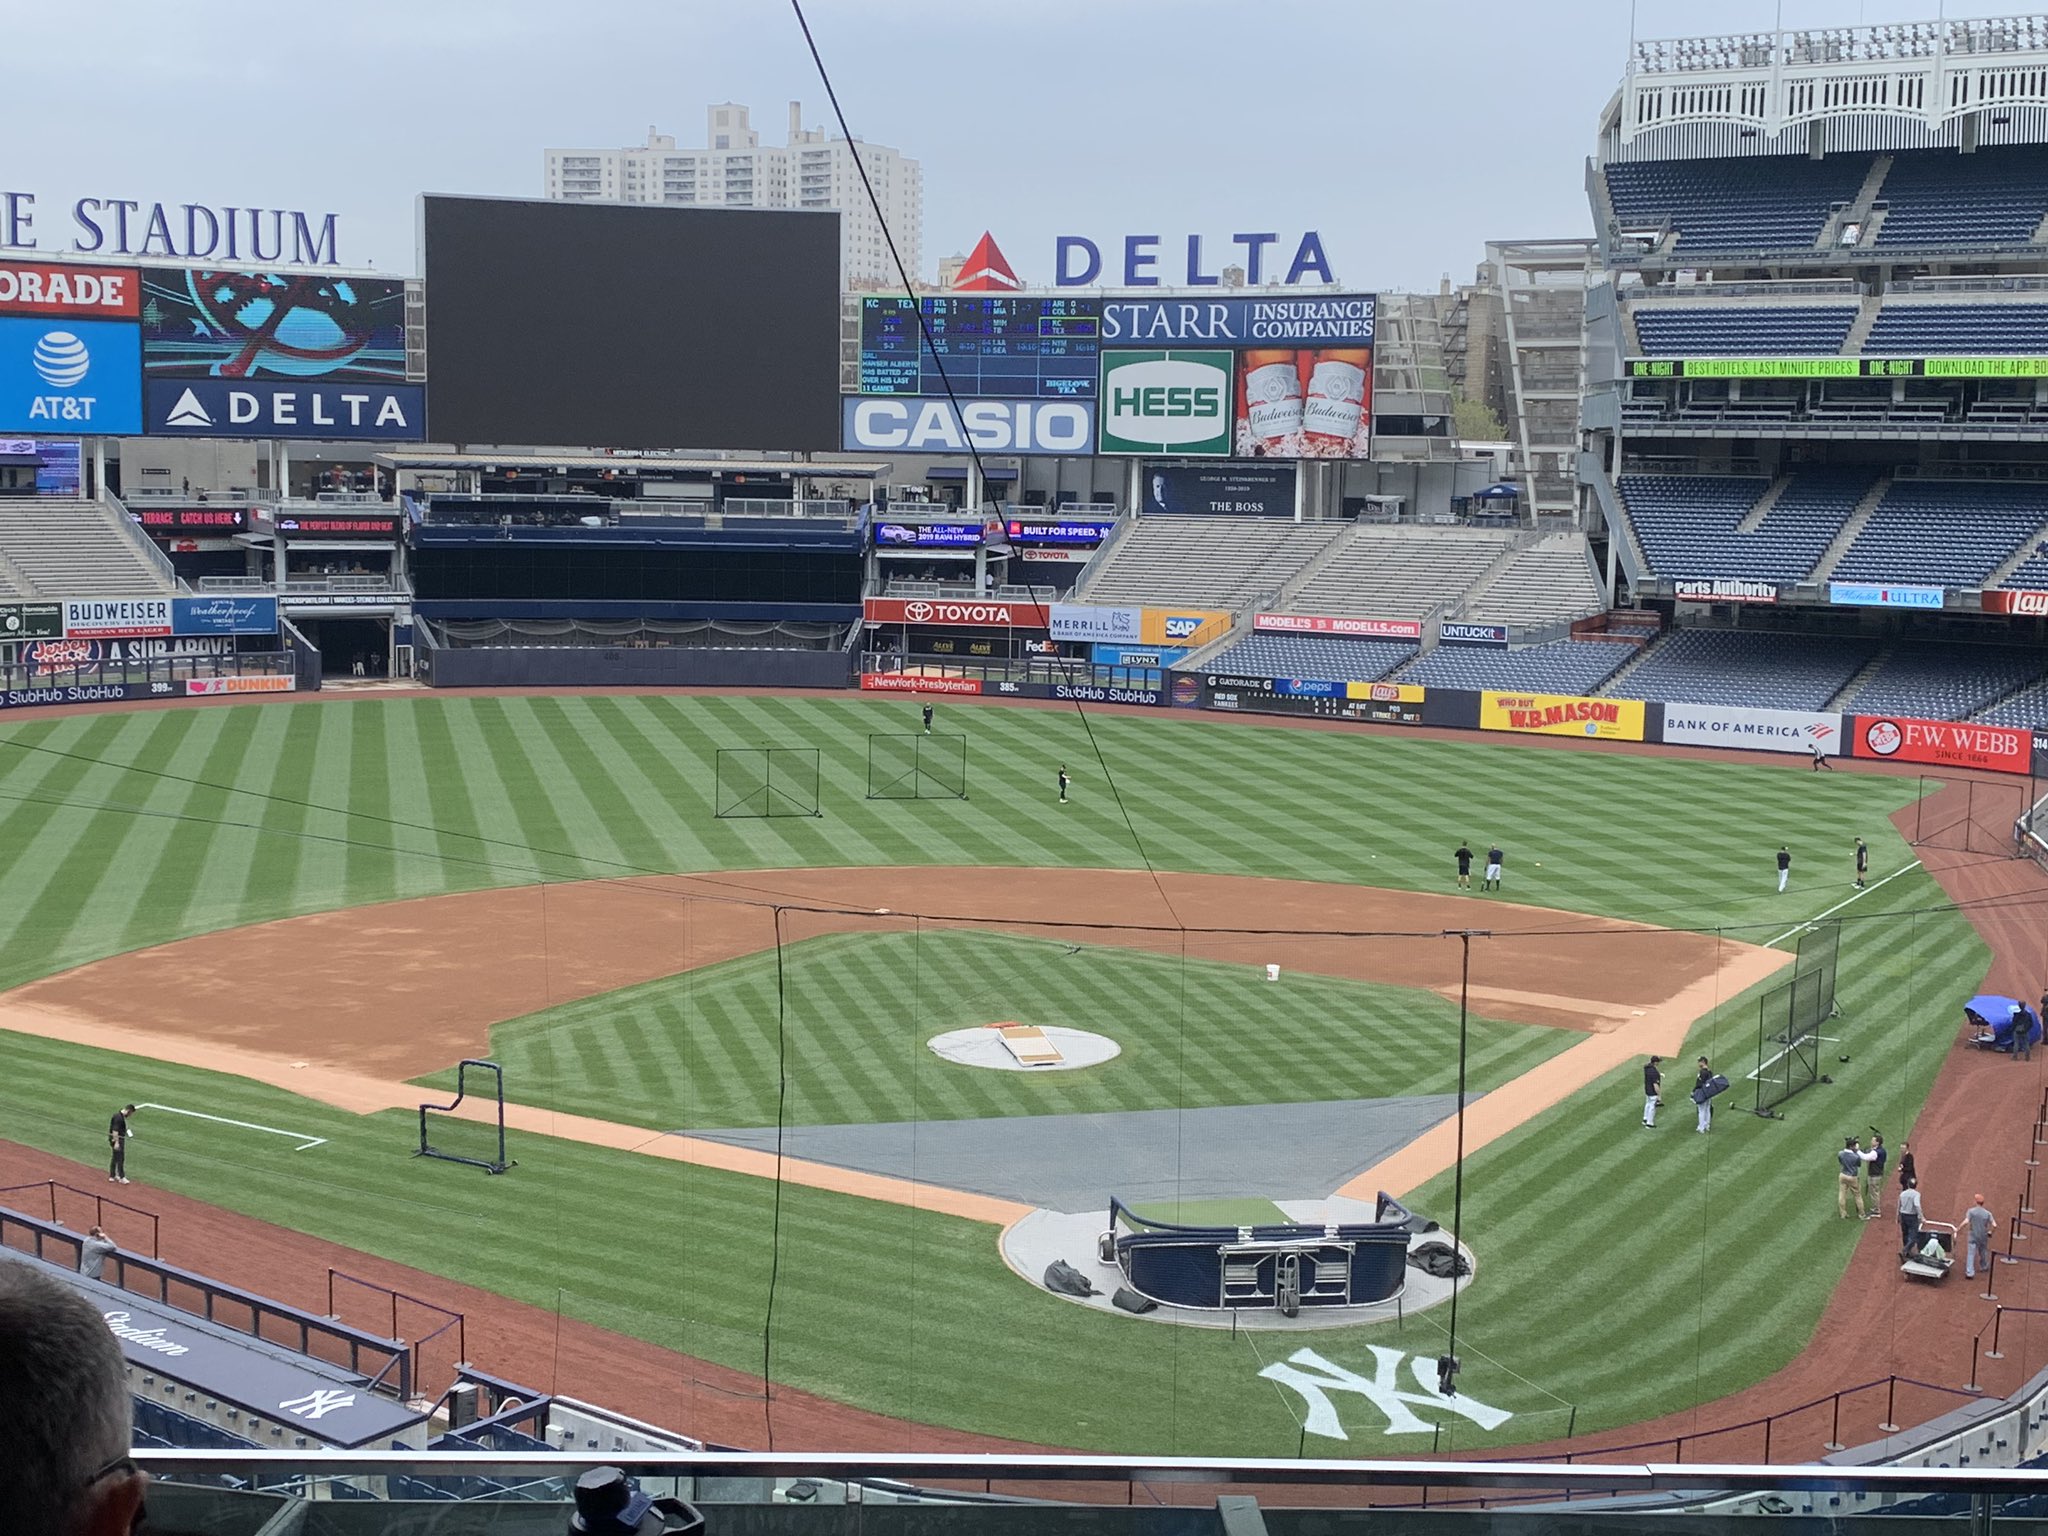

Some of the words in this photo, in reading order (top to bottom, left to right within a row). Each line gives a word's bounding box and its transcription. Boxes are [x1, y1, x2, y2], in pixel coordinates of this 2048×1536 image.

[73, 197, 340, 266] STADIUM
[1056, 231, 1334, 286] DELTA
[866, 299, 879, 308] KC
[897, 299, 914, 308] TEX
[1253, 301, 1374, 320] INSURANCE
[1102, 304, 1237, 339] STARR
[1253, 319, 1374, 338] COMPANIES
[1688, 361, 1710, 375] BEST
[1753, 362, 1777, 375] LAST
[1779, 361, 1815, 375] MINUTE
[1929, 360, 1984, 374] DOWNLOAD
[1988, 361, 2006, 374] THE
[29, 396, 96, 421] AT&T
[1114, 387, 1218, 417] HESS
[230, 391, 408, 428] DELTA
[854, 400, 1089, 450] CASIO
[1210, 502, 1232, 511] THE
[1235, 502, 1264, 512] BOSS
[142, 512, 174, 524] TERRACE
[181, 512, 202, 524] CATCH
[204, 512, 213, 524] US
[215, 512, 233, 524] HERE
[310, 521, 329, 530] PERFECT
[1023, 527, 1047, 535] BUILT
[1049, 527, 1066, 536] FOR
[1068, 528, 1097, 537] SPEED.
[1675, 581, 1711, 594] Parts
[1712, 581, 1776, 597] Authority
[1891, 593, 1940, 604] ULTRA
[70, 602, 167, 620] BUDWEISER
[936, 605, 1010, 622] TOYOTA
[1053, 620, 1108, 631] MERRILL
[1166, 620, 1197, 636] SAP
[1260, 616, 1311, 629] MODELL'S
[1333, 620, 1415, 634] MODELLS.com
[1443, 625, 1495, 638] UNTUCKit
[32, 640, 91, 659] Jersey
[109, 642, 122, 666] A
[1025, 640, 1059, 654] FedEx
[1131, 656, 1156, 664] LYNX
[152, 683, 168, 692] 399
[1000, 682, 1014, 691] 385
[1208, 676, 1216, 686] G
[1219, 678, 1260, 688] GATORADE
[1263, 680, 1272, 690] G
[1304, 682, 1332, 692] pepsi
[9, 689, 62, 704] StubHub
[68, 686, 123, 700] StubHub
[1057, 685, 1105, 701] StubHub
[1109, 688, 1156, 704] StubHub
[1497, 698, 1516, 707] WHO
[1519, 699, 1534, 708] BUT
[1668, 719, 1707, 730] BANK
[1711, 722, 1729, 731] OF
[1733, 724, 1800, 737] AMERICA
[1906, 724, 1945, 748] F.W.
[1951, 728, 2018, 755] WEBB
[2033, 737, 2048, 750] 314
[1935, 750, 1963, 761] SINCE
[103, 1310, 189, 1357] Stadium
